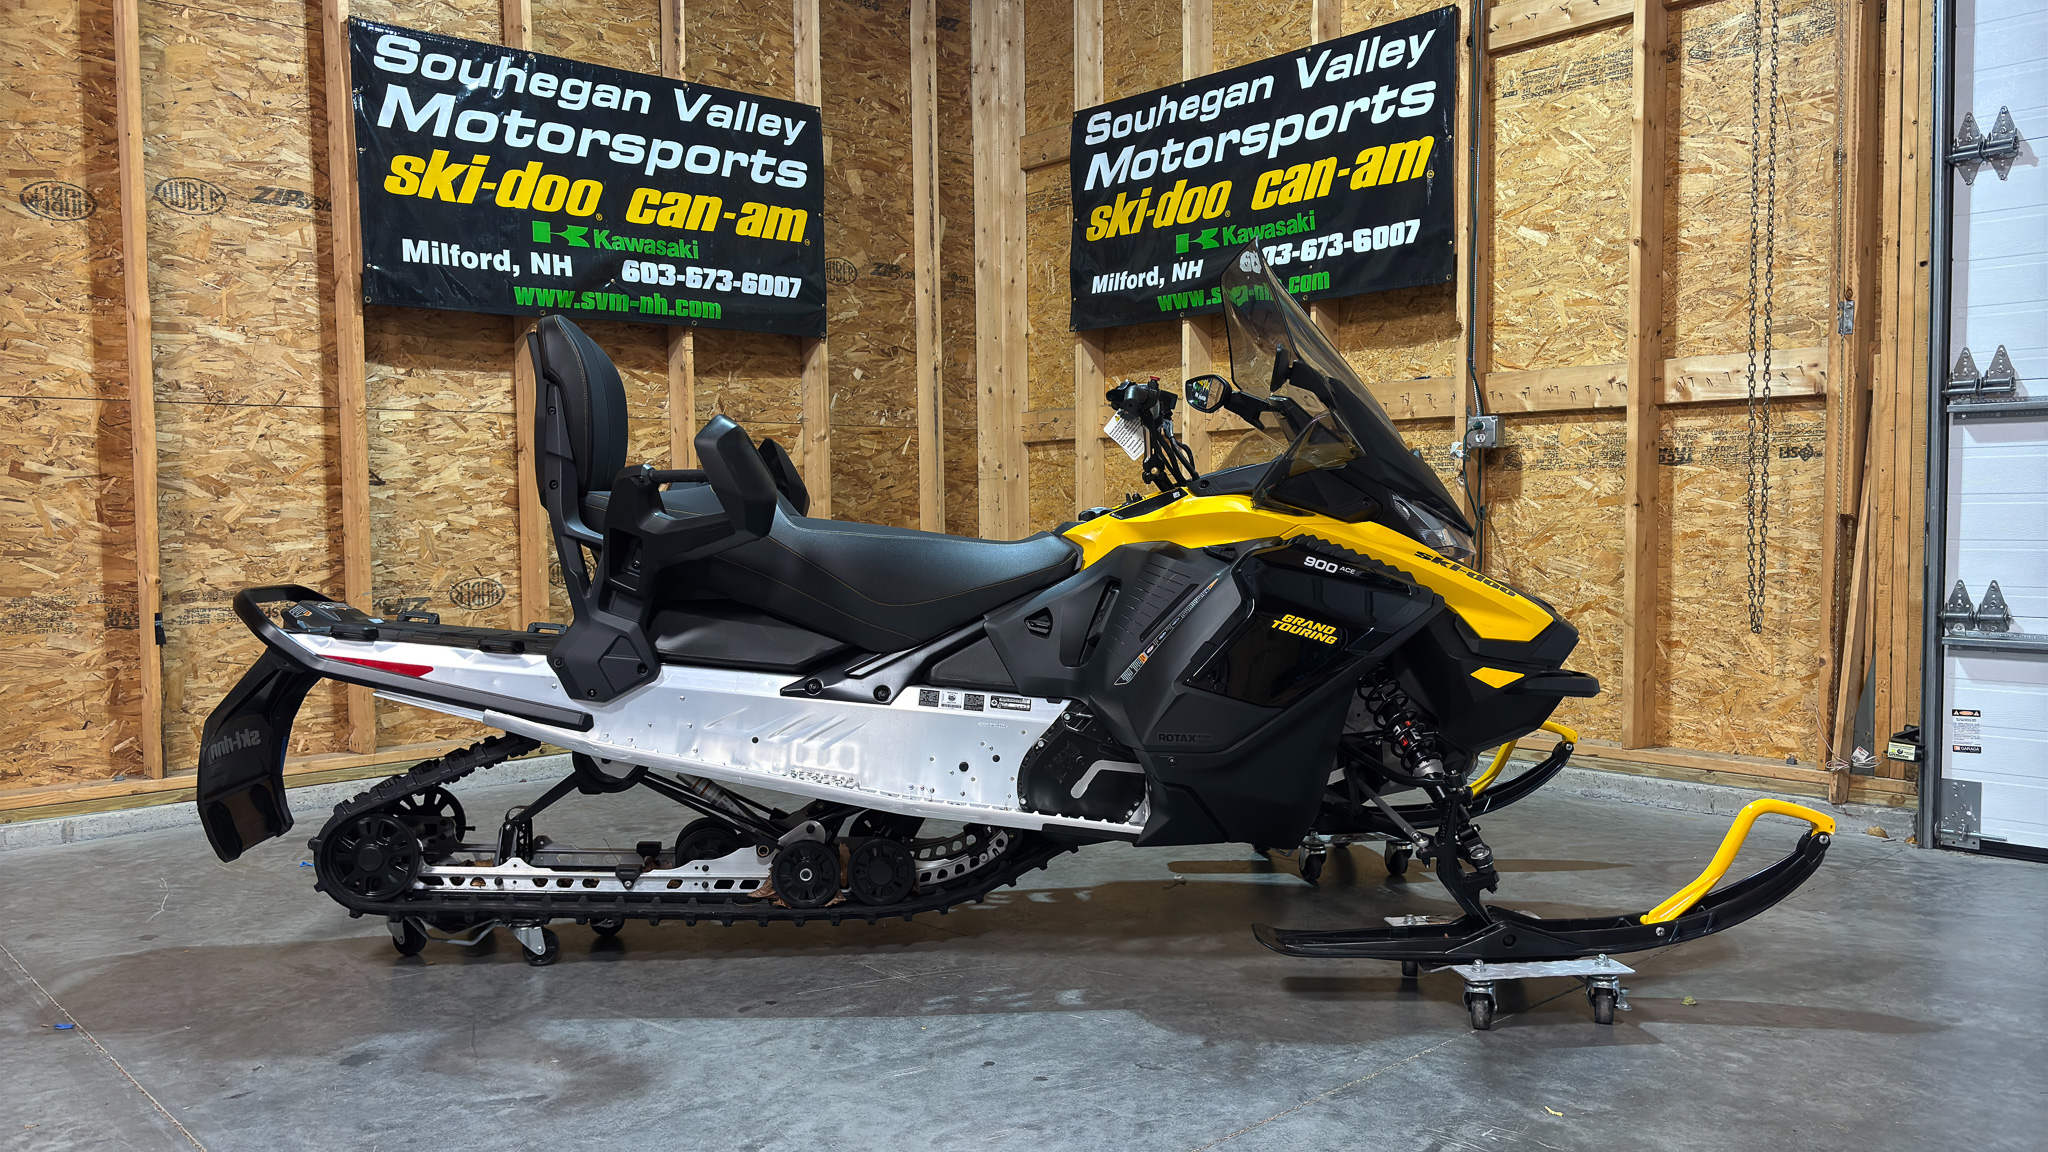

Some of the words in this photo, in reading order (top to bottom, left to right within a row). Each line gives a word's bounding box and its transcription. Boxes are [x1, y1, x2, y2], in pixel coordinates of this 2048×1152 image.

[373, 34, 651, 115] Souhegan
[673, 88, 807, 146] Valley
[1084, 74, 1275, 146] Souhegan
[1296, 28, 1436, 89] Valley
[377, 83, 808, 188] Motorsports
[1083, 81, 1437, 191] Motorsports
[383, 149, 604, 217] ski-doo
[625, 187, 808, 243] can-am
[1086, 179, 1232, 242] ski-doo
[1250, 135, 1435, 210] can-am
[593, 228, 699, 259] Kawasaki
[1222, 209, 1316, 246] Kawasaki
[401, 238, 520, 277] Milford,
[530, 252, 573, 277] NH
[1091, 266, 1165, 294] Milford,
[1171, 259, 1204, 283] NH
[621, 259, 802, 299] 603-673-6007
[513, 286, 722, 320] www.svm-nh.com
[1303, 556, 1338, 573] 900
[1339, 566, 1356, 574] ACE
[1271, 620, 1338, 645] TOURING
[1281, 614, 1336, 635] GRAND
[1158, 733, 1196, 743] ROTAX
